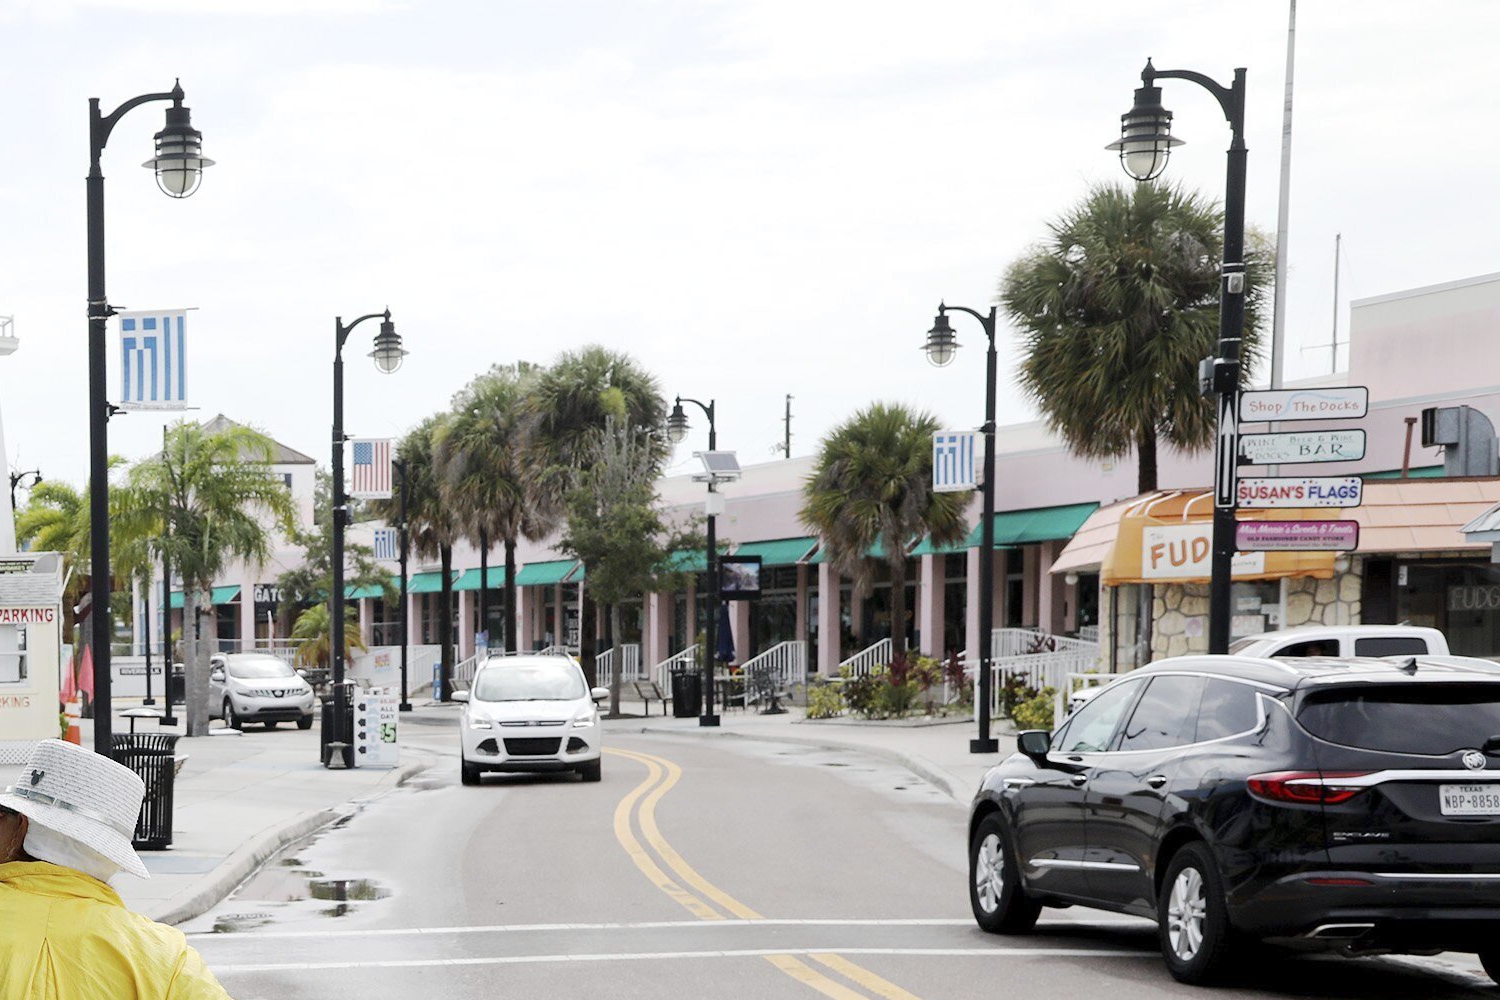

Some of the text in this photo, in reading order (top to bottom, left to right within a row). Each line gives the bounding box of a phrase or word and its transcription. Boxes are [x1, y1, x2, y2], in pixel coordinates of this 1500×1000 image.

[1249, 401, 1359, 414] Shop The Docks
[1299, 443, 1343, 456] BAR
[1239, 486, 1358, 499] SUSAN'S FLAGS
